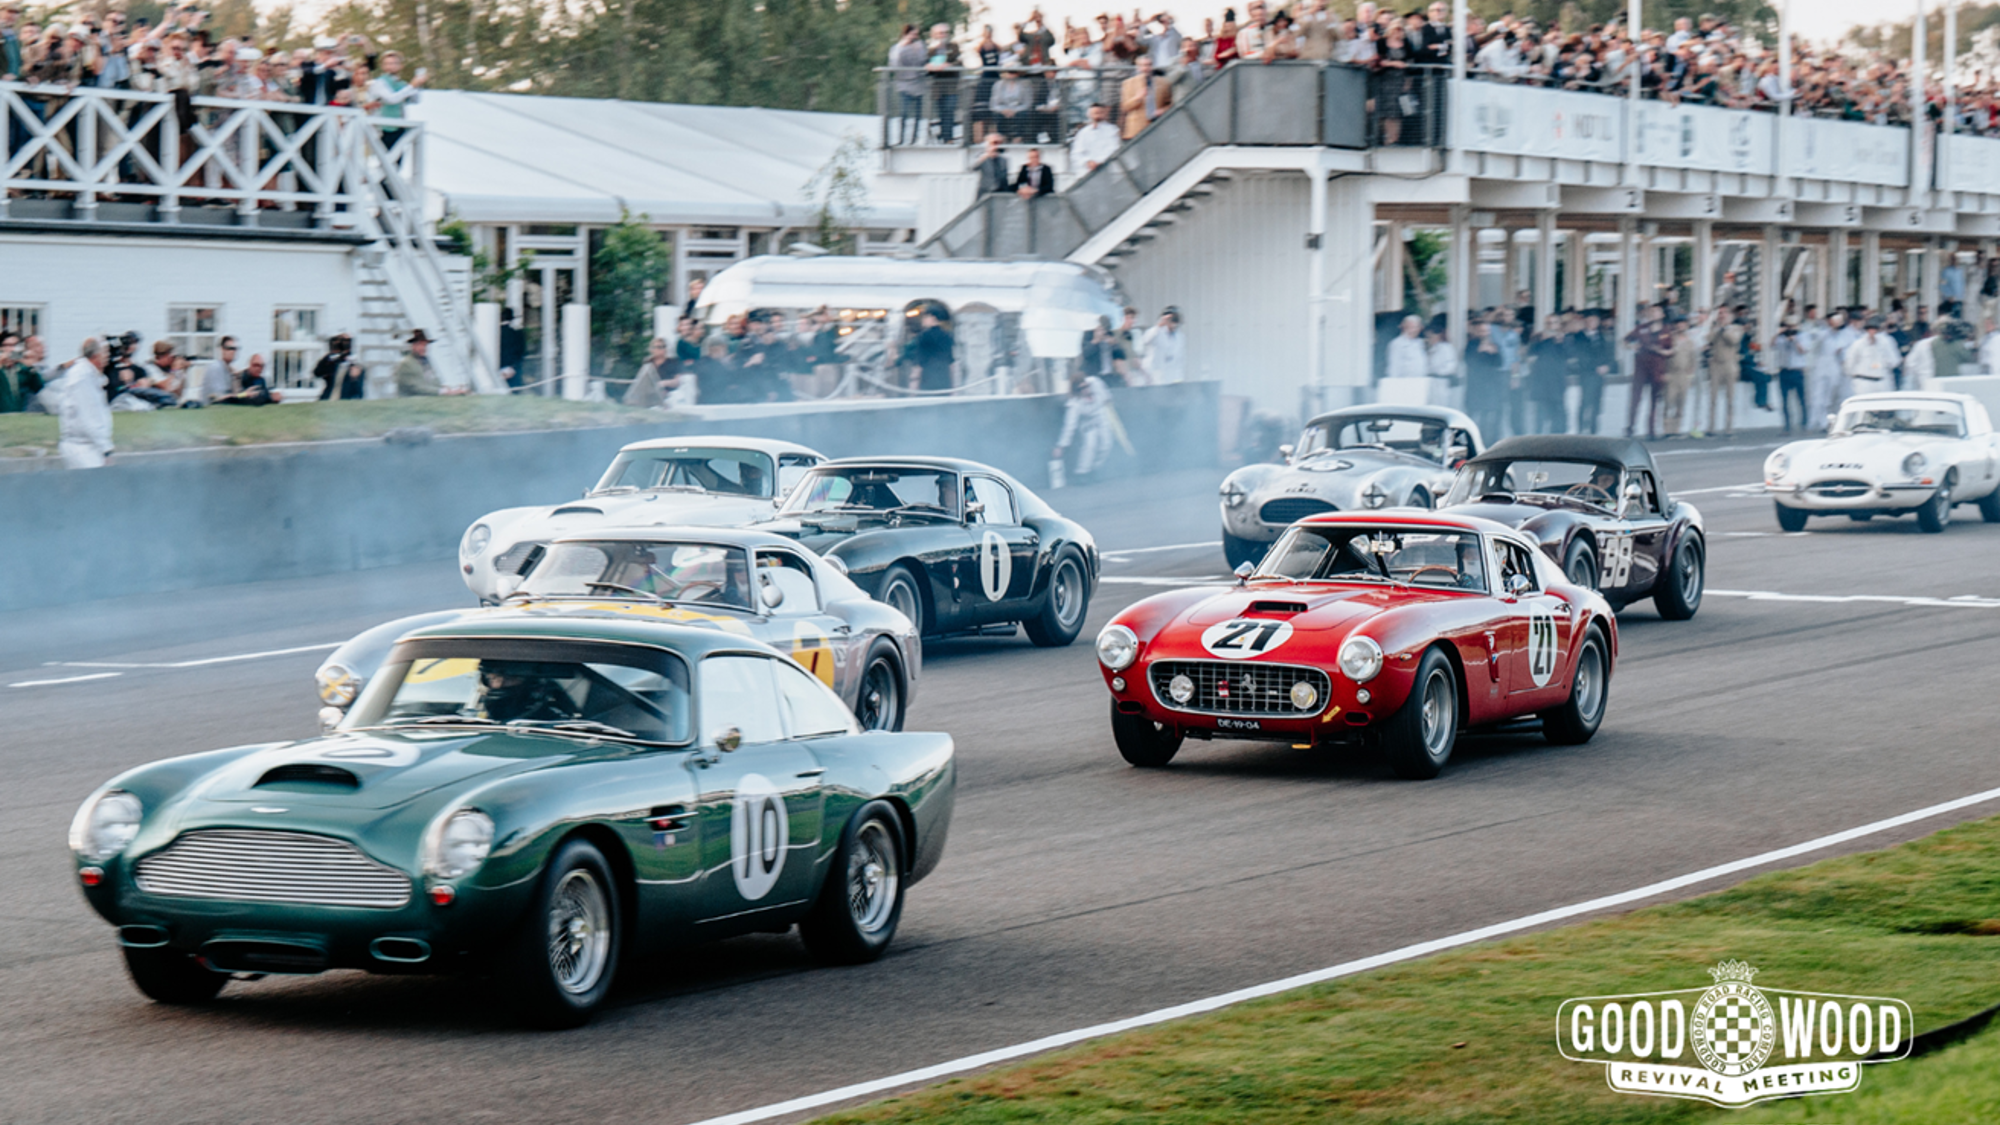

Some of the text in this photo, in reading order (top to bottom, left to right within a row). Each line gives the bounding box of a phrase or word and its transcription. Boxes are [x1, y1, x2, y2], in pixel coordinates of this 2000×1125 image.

[1626, 190, 1639, 208] 2
[990, 534, 1000, 593] 1
[1599, 537, 1633, 588] 98
[1210, 621, 1283, 651] 21
[1533, 615, 1552, 675] 21
[742, 796, 780, 880] 10
